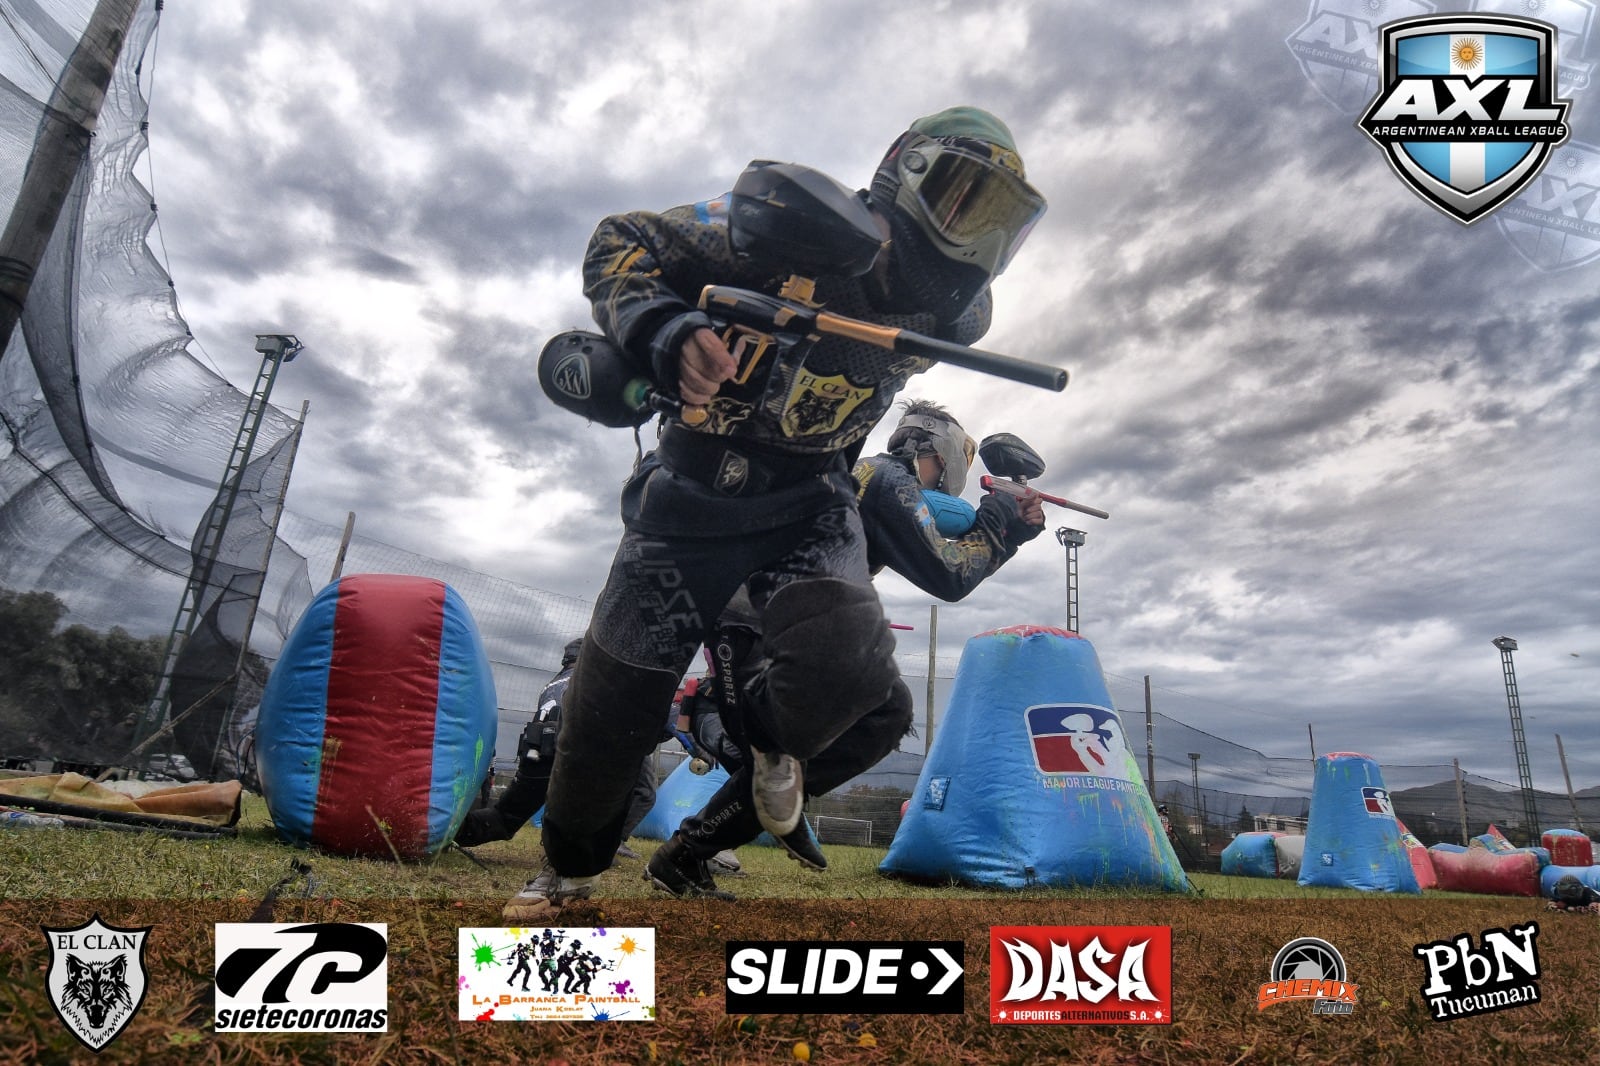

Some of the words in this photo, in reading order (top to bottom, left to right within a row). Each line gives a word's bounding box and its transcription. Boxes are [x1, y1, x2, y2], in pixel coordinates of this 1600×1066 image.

[799, 375, 817, 389] EL
[821, 382, 865, 400] CLAN
[1042, 777, 1080, 790] MAJOR
[1081, 777, 1115, 791] LEAGUE
